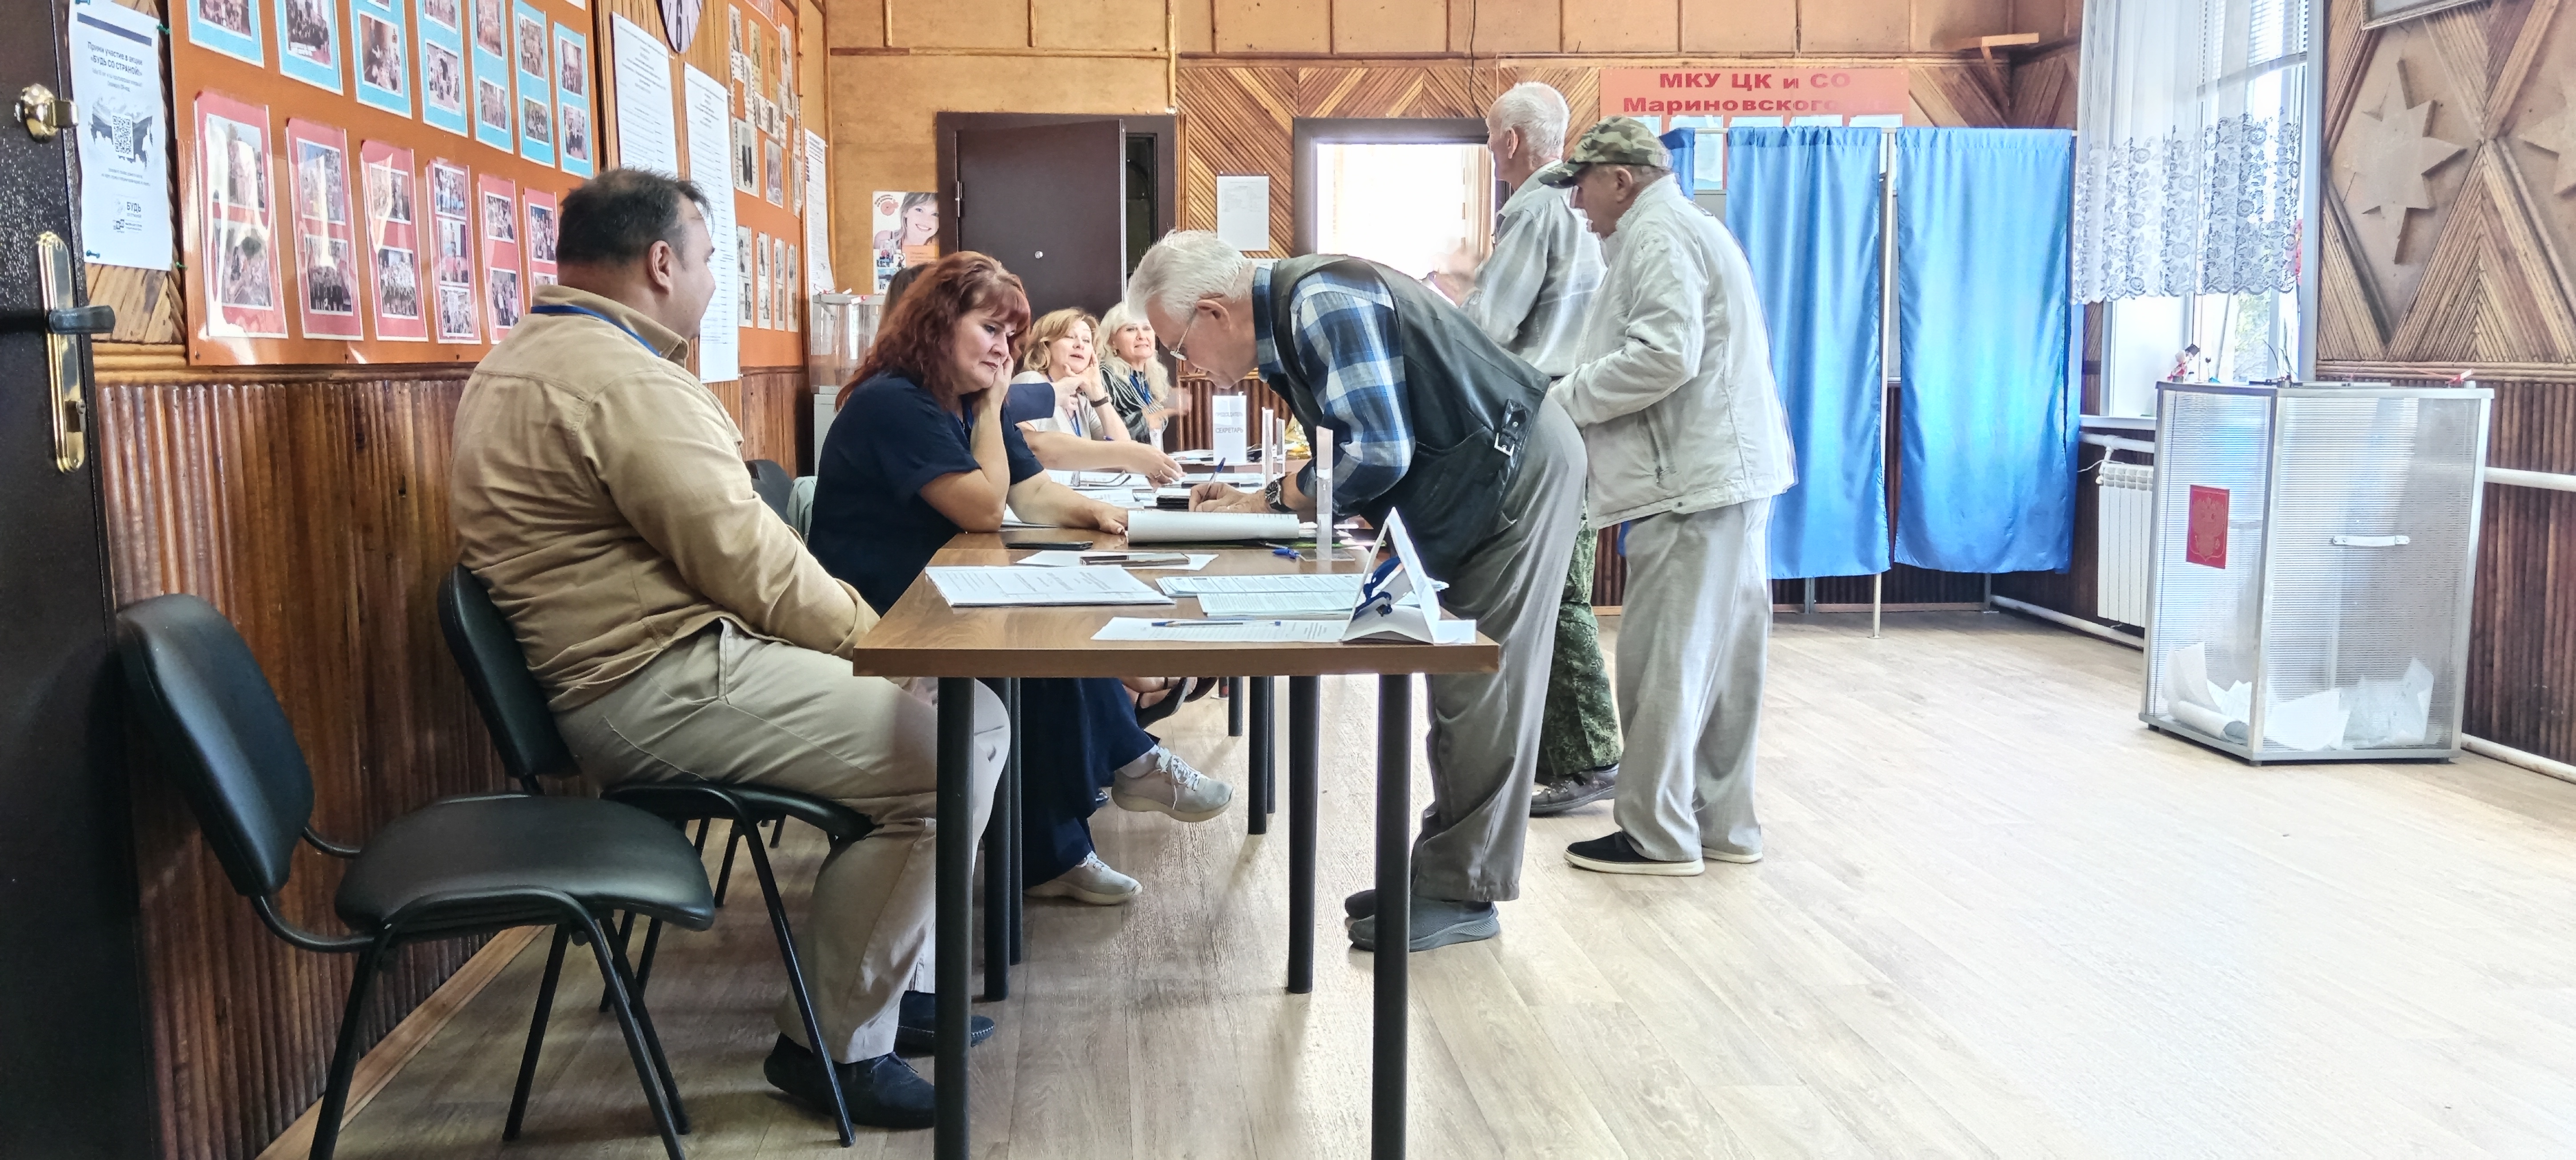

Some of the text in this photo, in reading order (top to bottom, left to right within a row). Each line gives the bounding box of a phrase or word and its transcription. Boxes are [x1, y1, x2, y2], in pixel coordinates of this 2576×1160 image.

[108, 60, 115, 68] СО
[1660, 73, 1851, 92] МКУ ЦК и СО
[126, 201, 141, 213] БУДЬ
